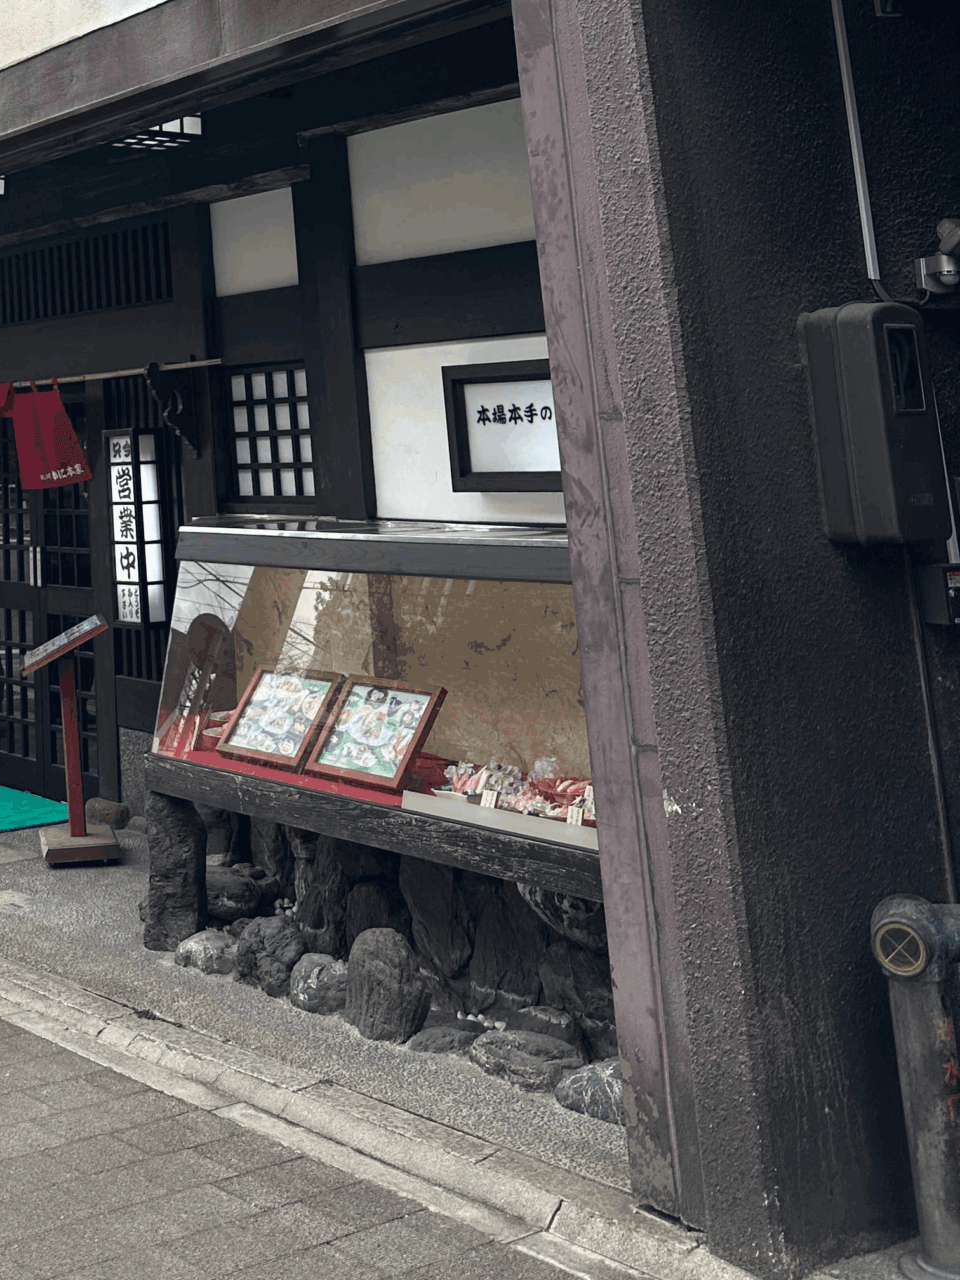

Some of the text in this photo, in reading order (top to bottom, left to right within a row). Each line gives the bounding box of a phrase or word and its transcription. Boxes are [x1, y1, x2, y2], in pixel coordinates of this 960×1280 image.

[476, 403, 553, 426] 本場本手の
[115, 467, 137, 580] 営業中
